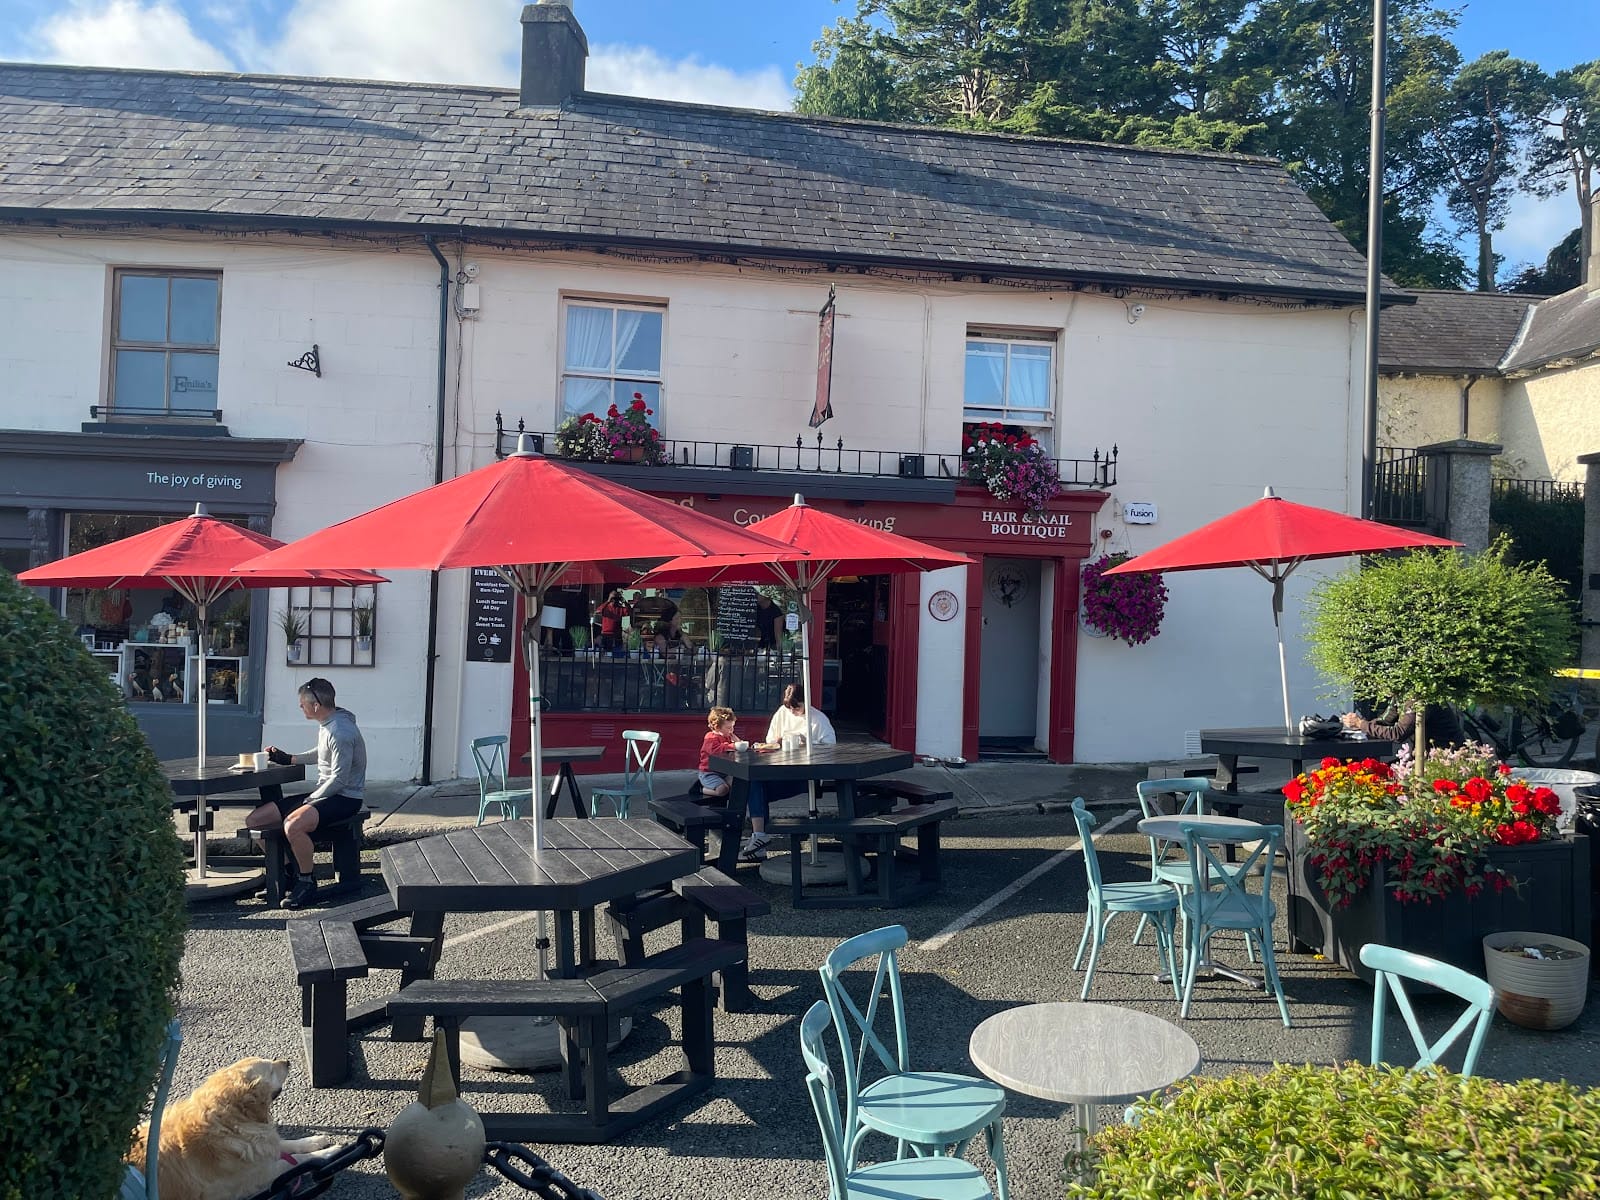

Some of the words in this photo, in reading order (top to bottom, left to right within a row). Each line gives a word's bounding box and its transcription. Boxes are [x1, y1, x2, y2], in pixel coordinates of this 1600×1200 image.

[147, 472, 169, 484] The
[170, 473, 190, 488] joy
[191, 473, 205, 485] of
[206, 474, 242, 490] giving
[981, 511, 1018, 523] HAIR
[1021, 513, 1033, 524] &
[1038, 514, 1073, 526] NAIL
[1130, 508, 1154, 518] fusion
[991, 524, 1066, 539] BOUTIQUE
